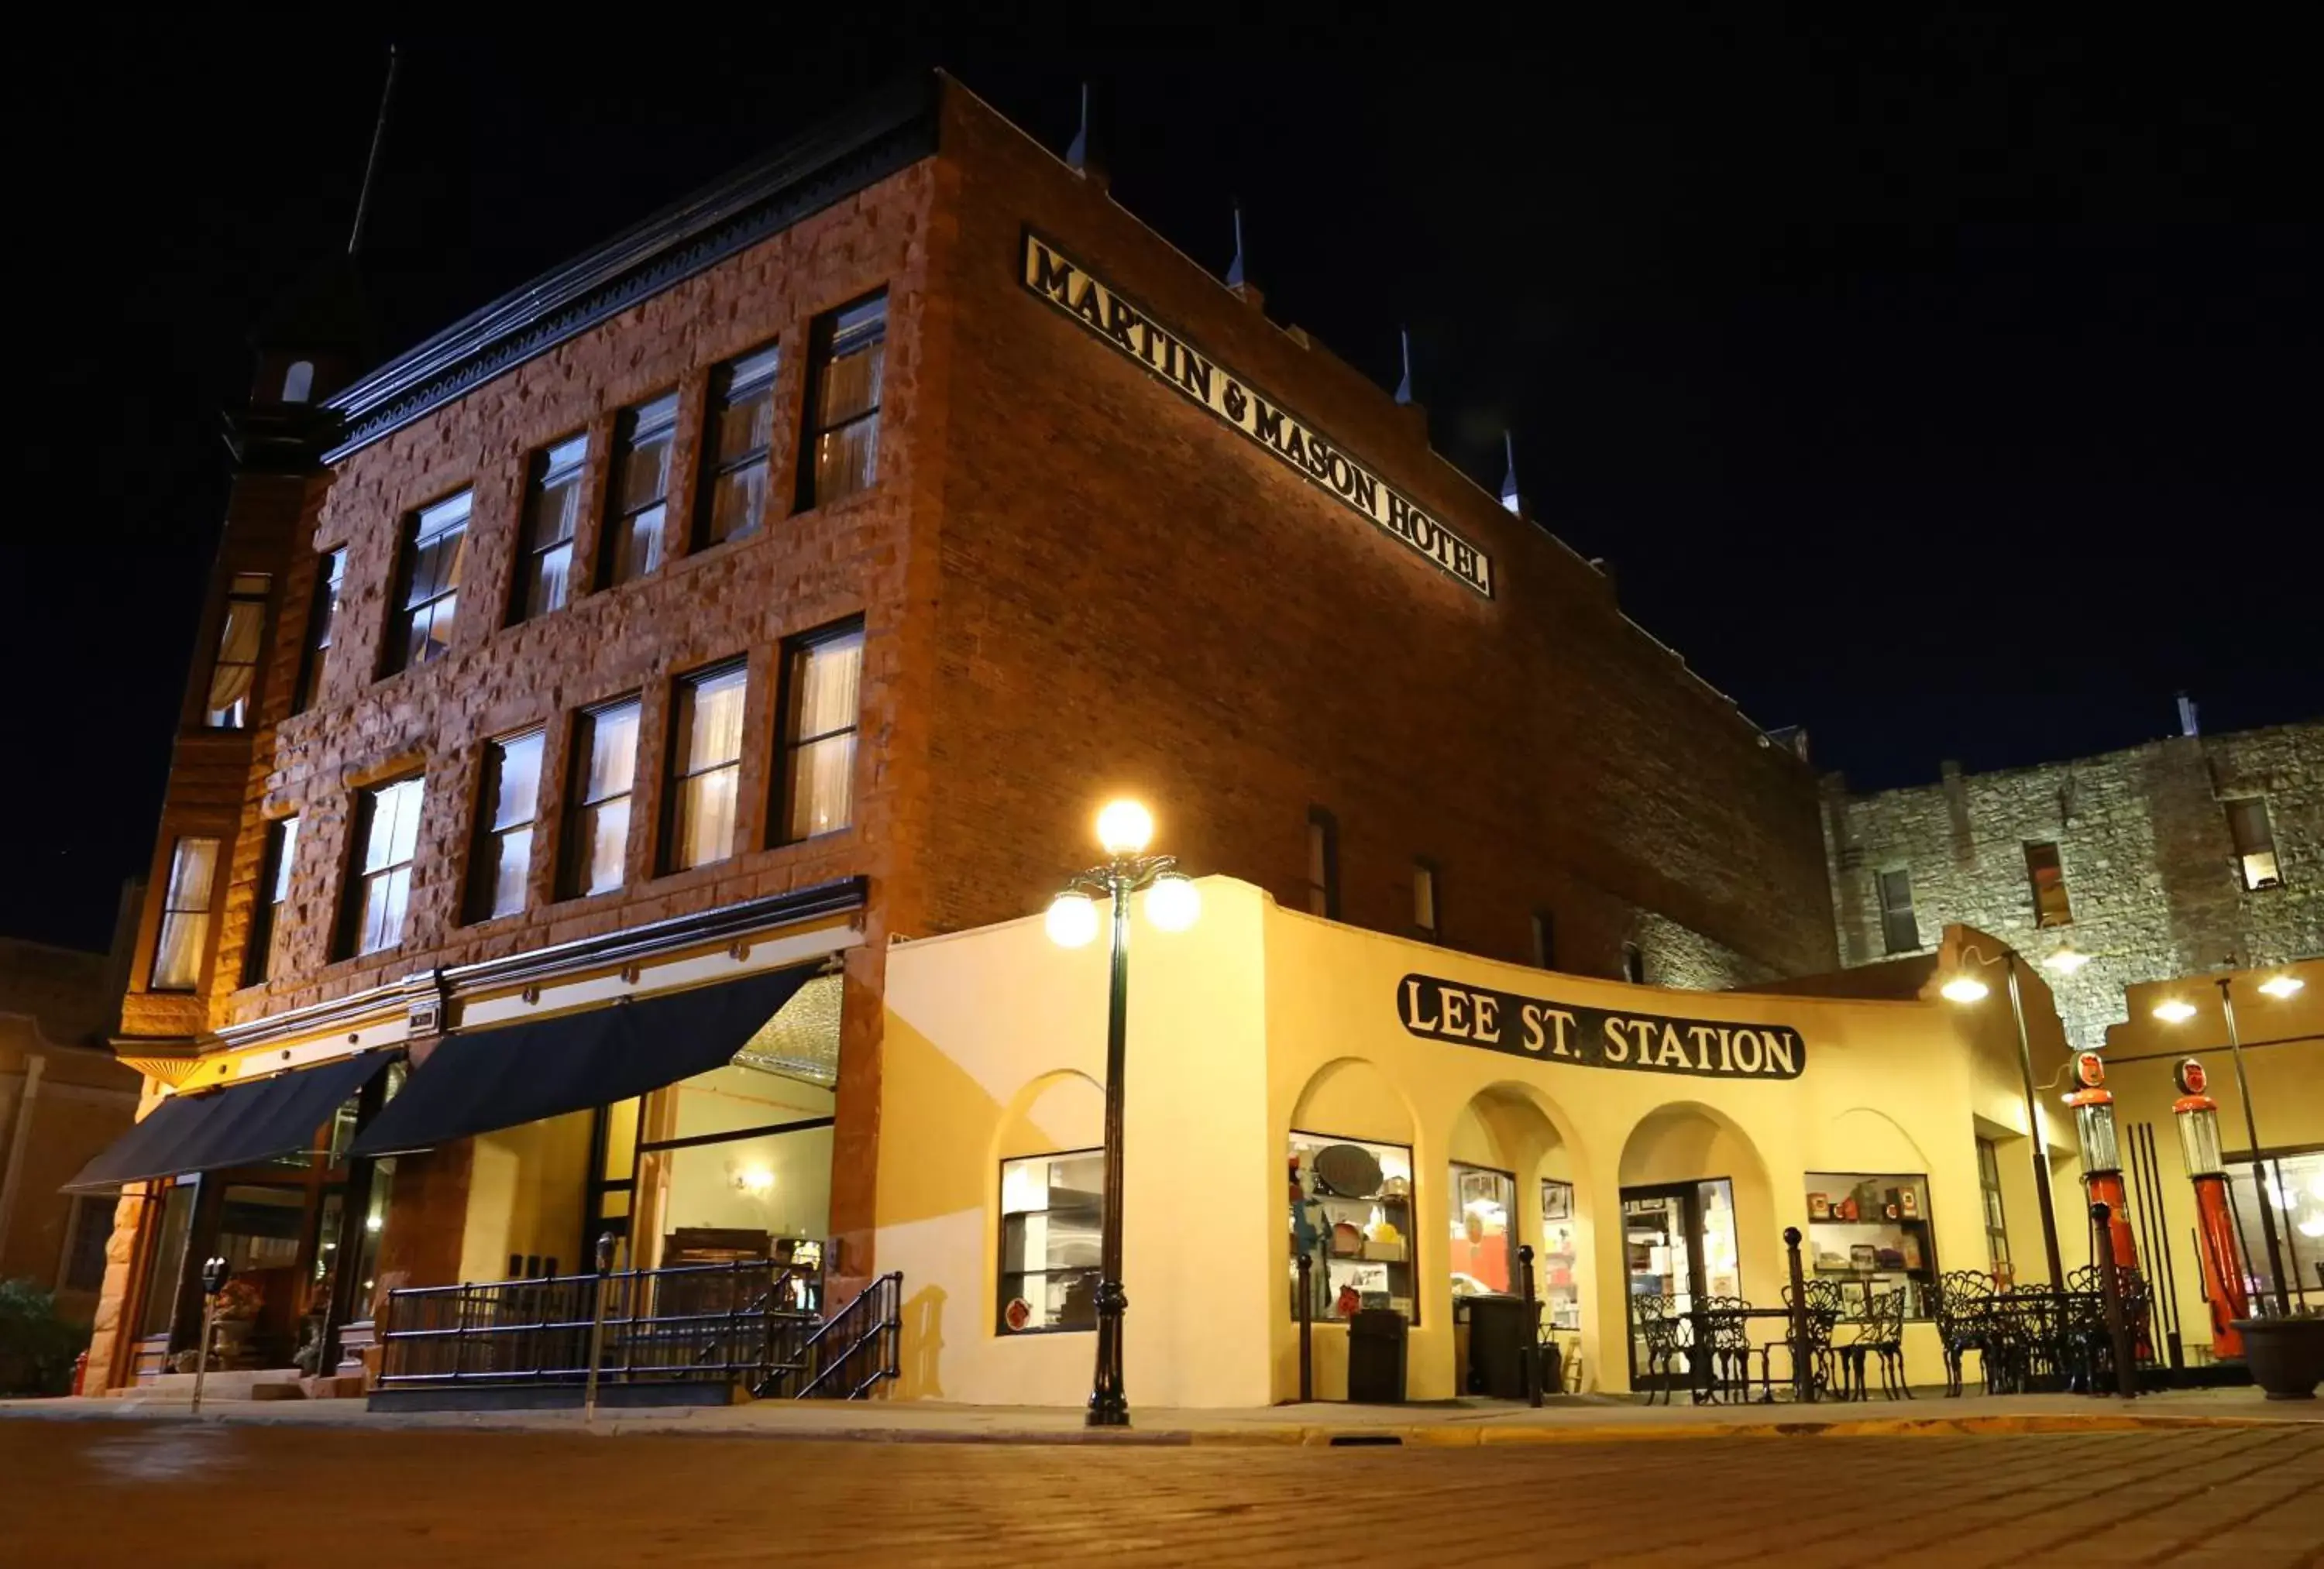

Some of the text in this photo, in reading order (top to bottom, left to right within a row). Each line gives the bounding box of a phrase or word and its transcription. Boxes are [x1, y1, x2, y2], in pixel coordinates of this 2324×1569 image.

[1035, 245, 1487, 591] MARTIN & MASON HOTEL
[1407, 980, 1796, 1073] LEE ST. STATION
